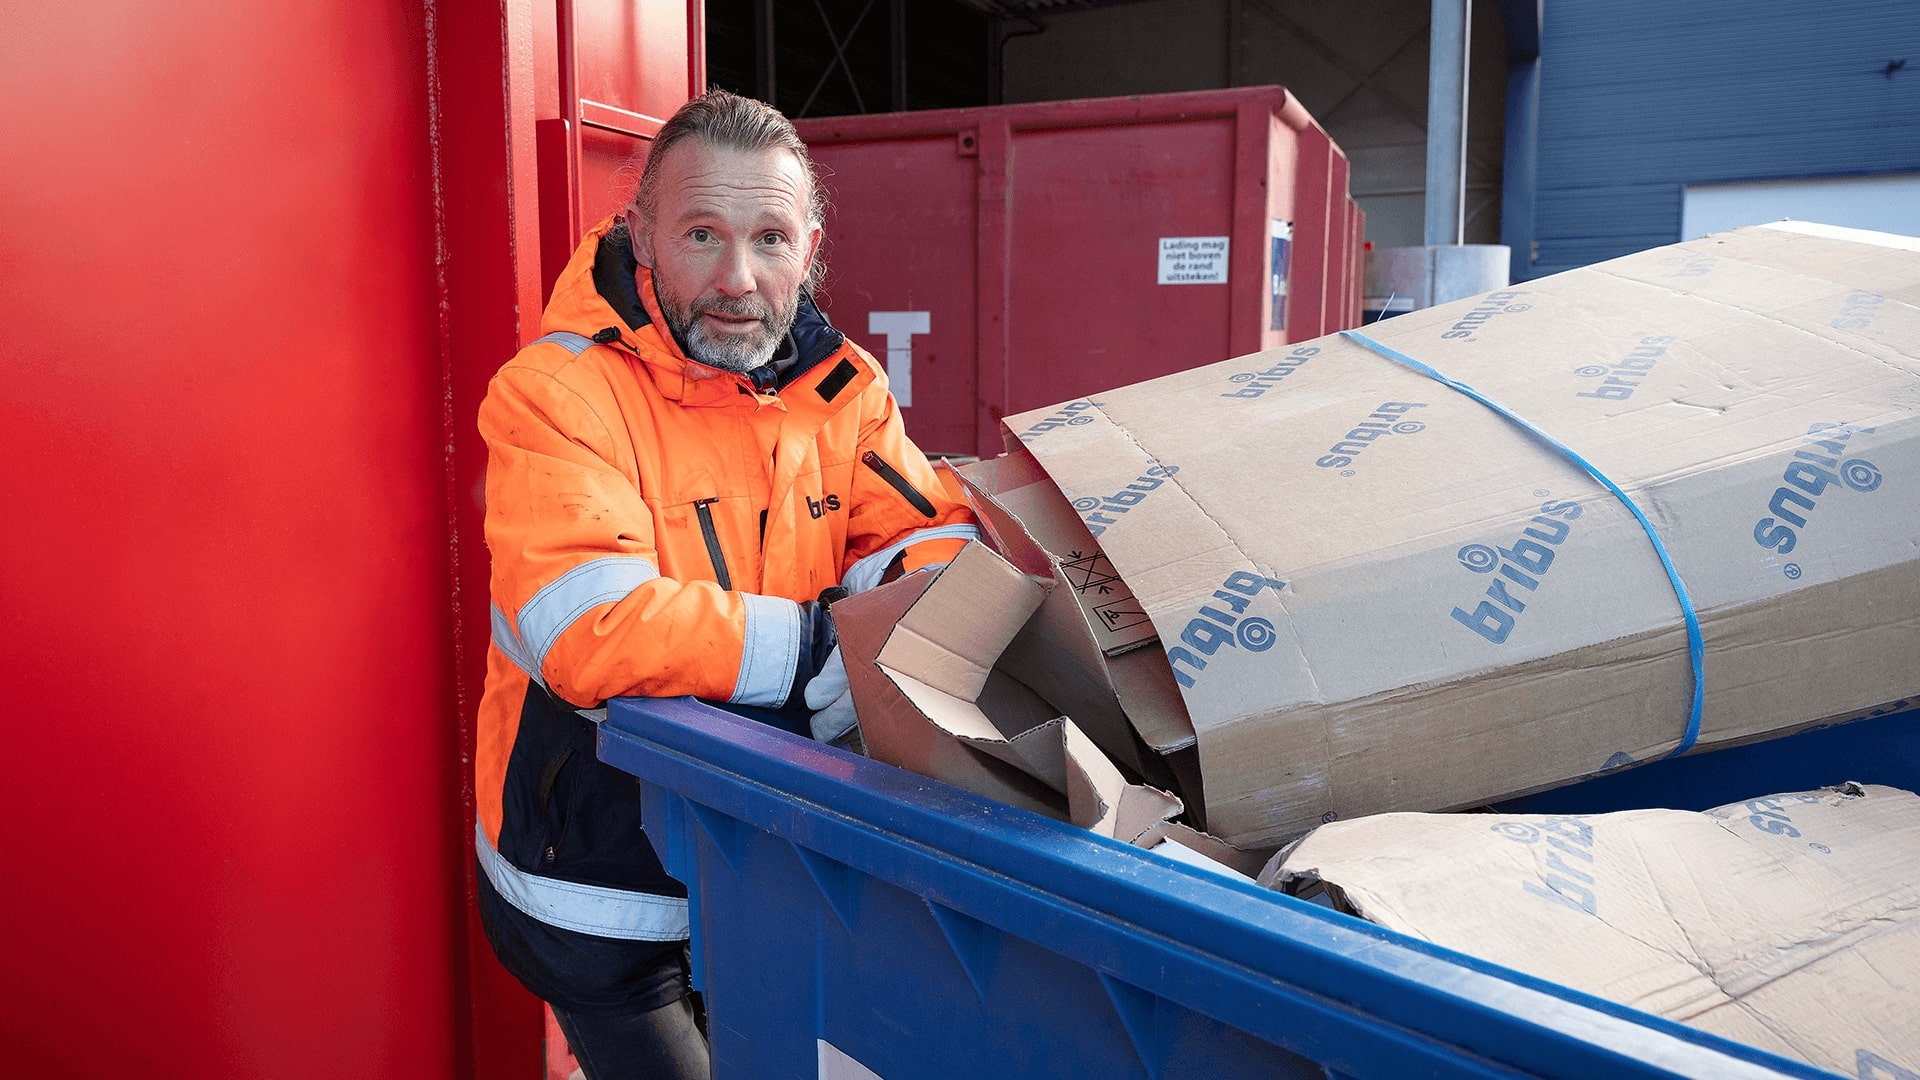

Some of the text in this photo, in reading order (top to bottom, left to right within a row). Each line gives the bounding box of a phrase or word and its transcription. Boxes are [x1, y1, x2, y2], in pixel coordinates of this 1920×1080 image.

[1163, 241, 1225, 250] Lading mag
[1166, 252, 1222, 260] niet boven
[1173, 262, 1213, 270] de rand
[1166, 272, 1219, 281] uitsteken!
[1441, 291, 1533, 339] bribus
[1831, 289, 1884, 329] bus
[868, 311, 931, 407] T
[1221, 346, 1320, 399] bribus
[1574, 336, 1677, 401] bribus
[1018, 402, 1106, 442] bribu
[1316, 401, 1429, 469] bribus
[1753, 422, 1882, 555] bribus
[1450, 499, 1584, 644] bribus
[1167, 570, 1287, 690] bribu
